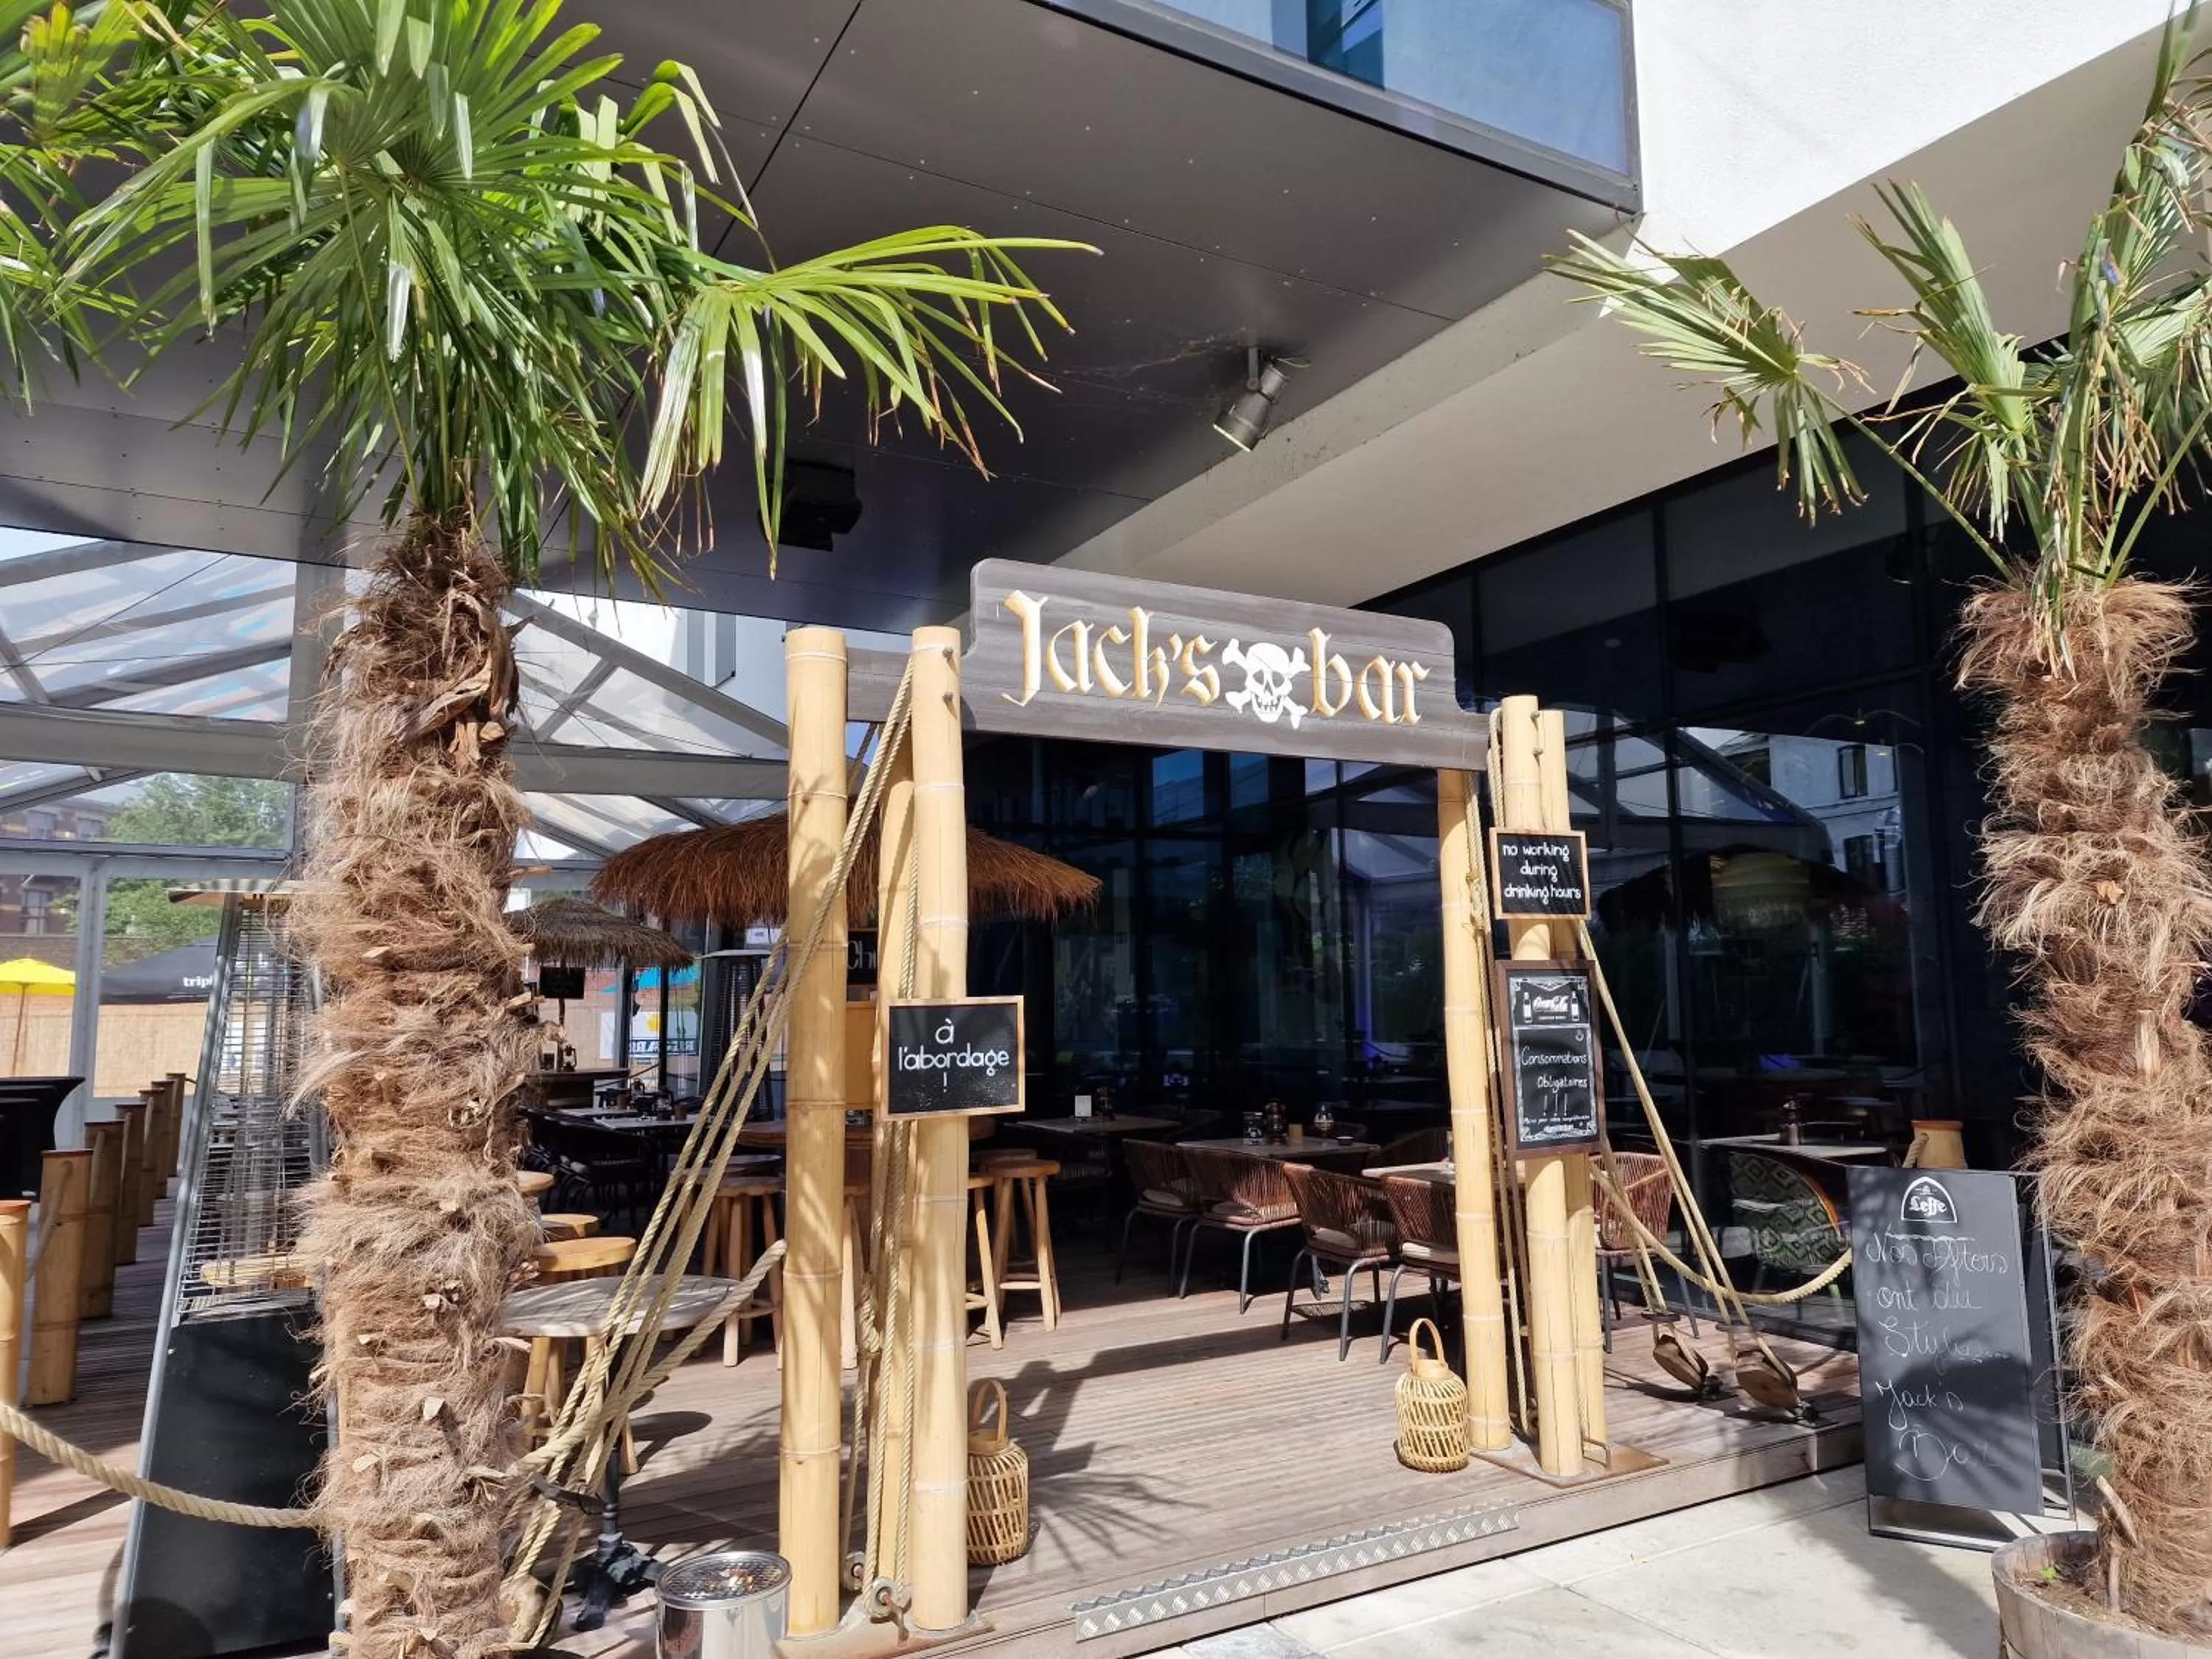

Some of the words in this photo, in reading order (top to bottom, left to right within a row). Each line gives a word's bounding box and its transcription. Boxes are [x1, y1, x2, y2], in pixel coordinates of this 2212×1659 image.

[1001, 590, 1218, 708] Jack's
[1307, 627, 1430, 726] bar
[1502, 844, 1518, 856] no
[1523, 842, 1570, 862] working
[1520, 860, 1558, 883] during
[1504, 883, 1549, 905] drinking
[1550, 884, 1582, 899] hours
[935, 1018, 955, 1044] à
[898, 1043, 1010, 1077] l'abordage
[1909, 1195, 1947, 1217] Leffe
[1877, 1279, 1919, 1310] ont
